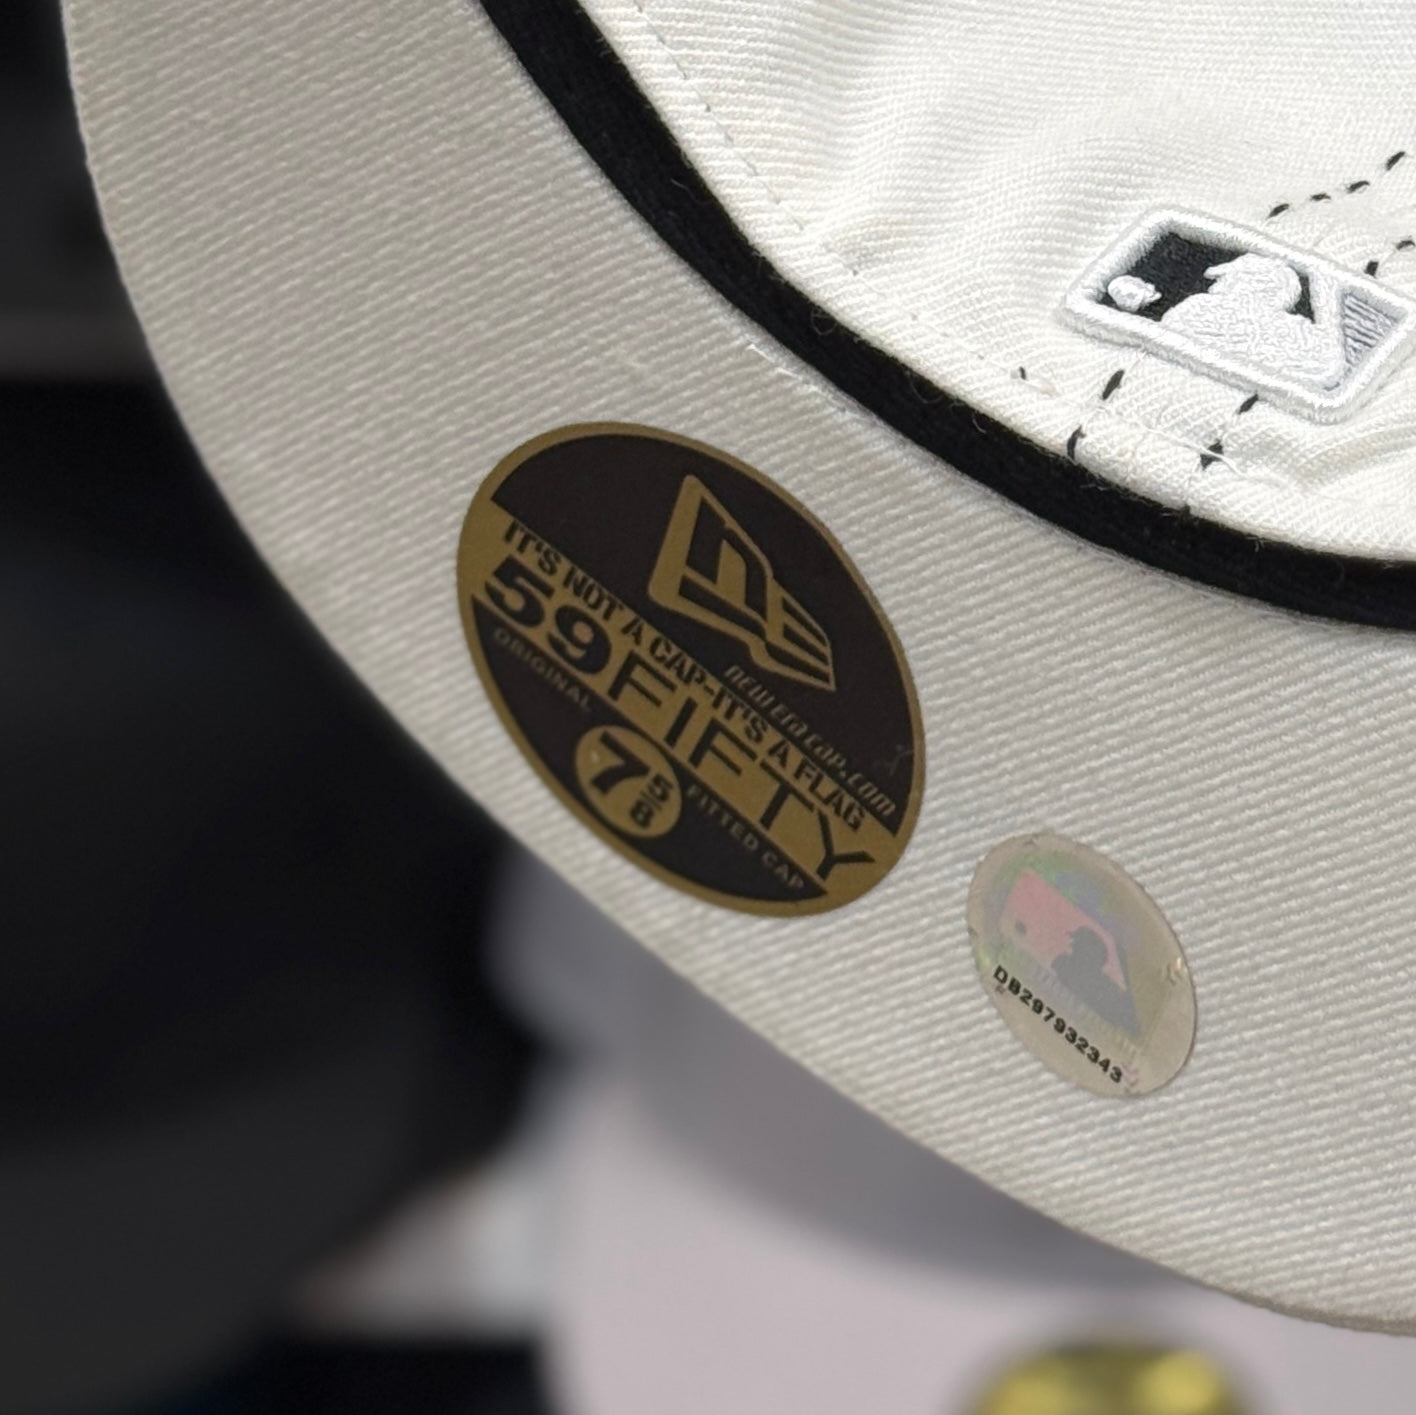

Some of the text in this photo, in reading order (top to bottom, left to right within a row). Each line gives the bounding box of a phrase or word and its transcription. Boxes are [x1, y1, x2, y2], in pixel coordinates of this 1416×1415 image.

[485, 556, 876, 882] 59FIFTY
[494, 627, 592, 713] ORIGINAL
[505, 520, 561, 576] IT'S
[563, 566, 625, 622] NOT
[621, 615, 645, 646] A
[768, 739, 790, 768] A
[794, 756, 865, 832] FLAG
[592, 730, 650, 794] 7
[684, 785, 805, 889] FITTED CAP
